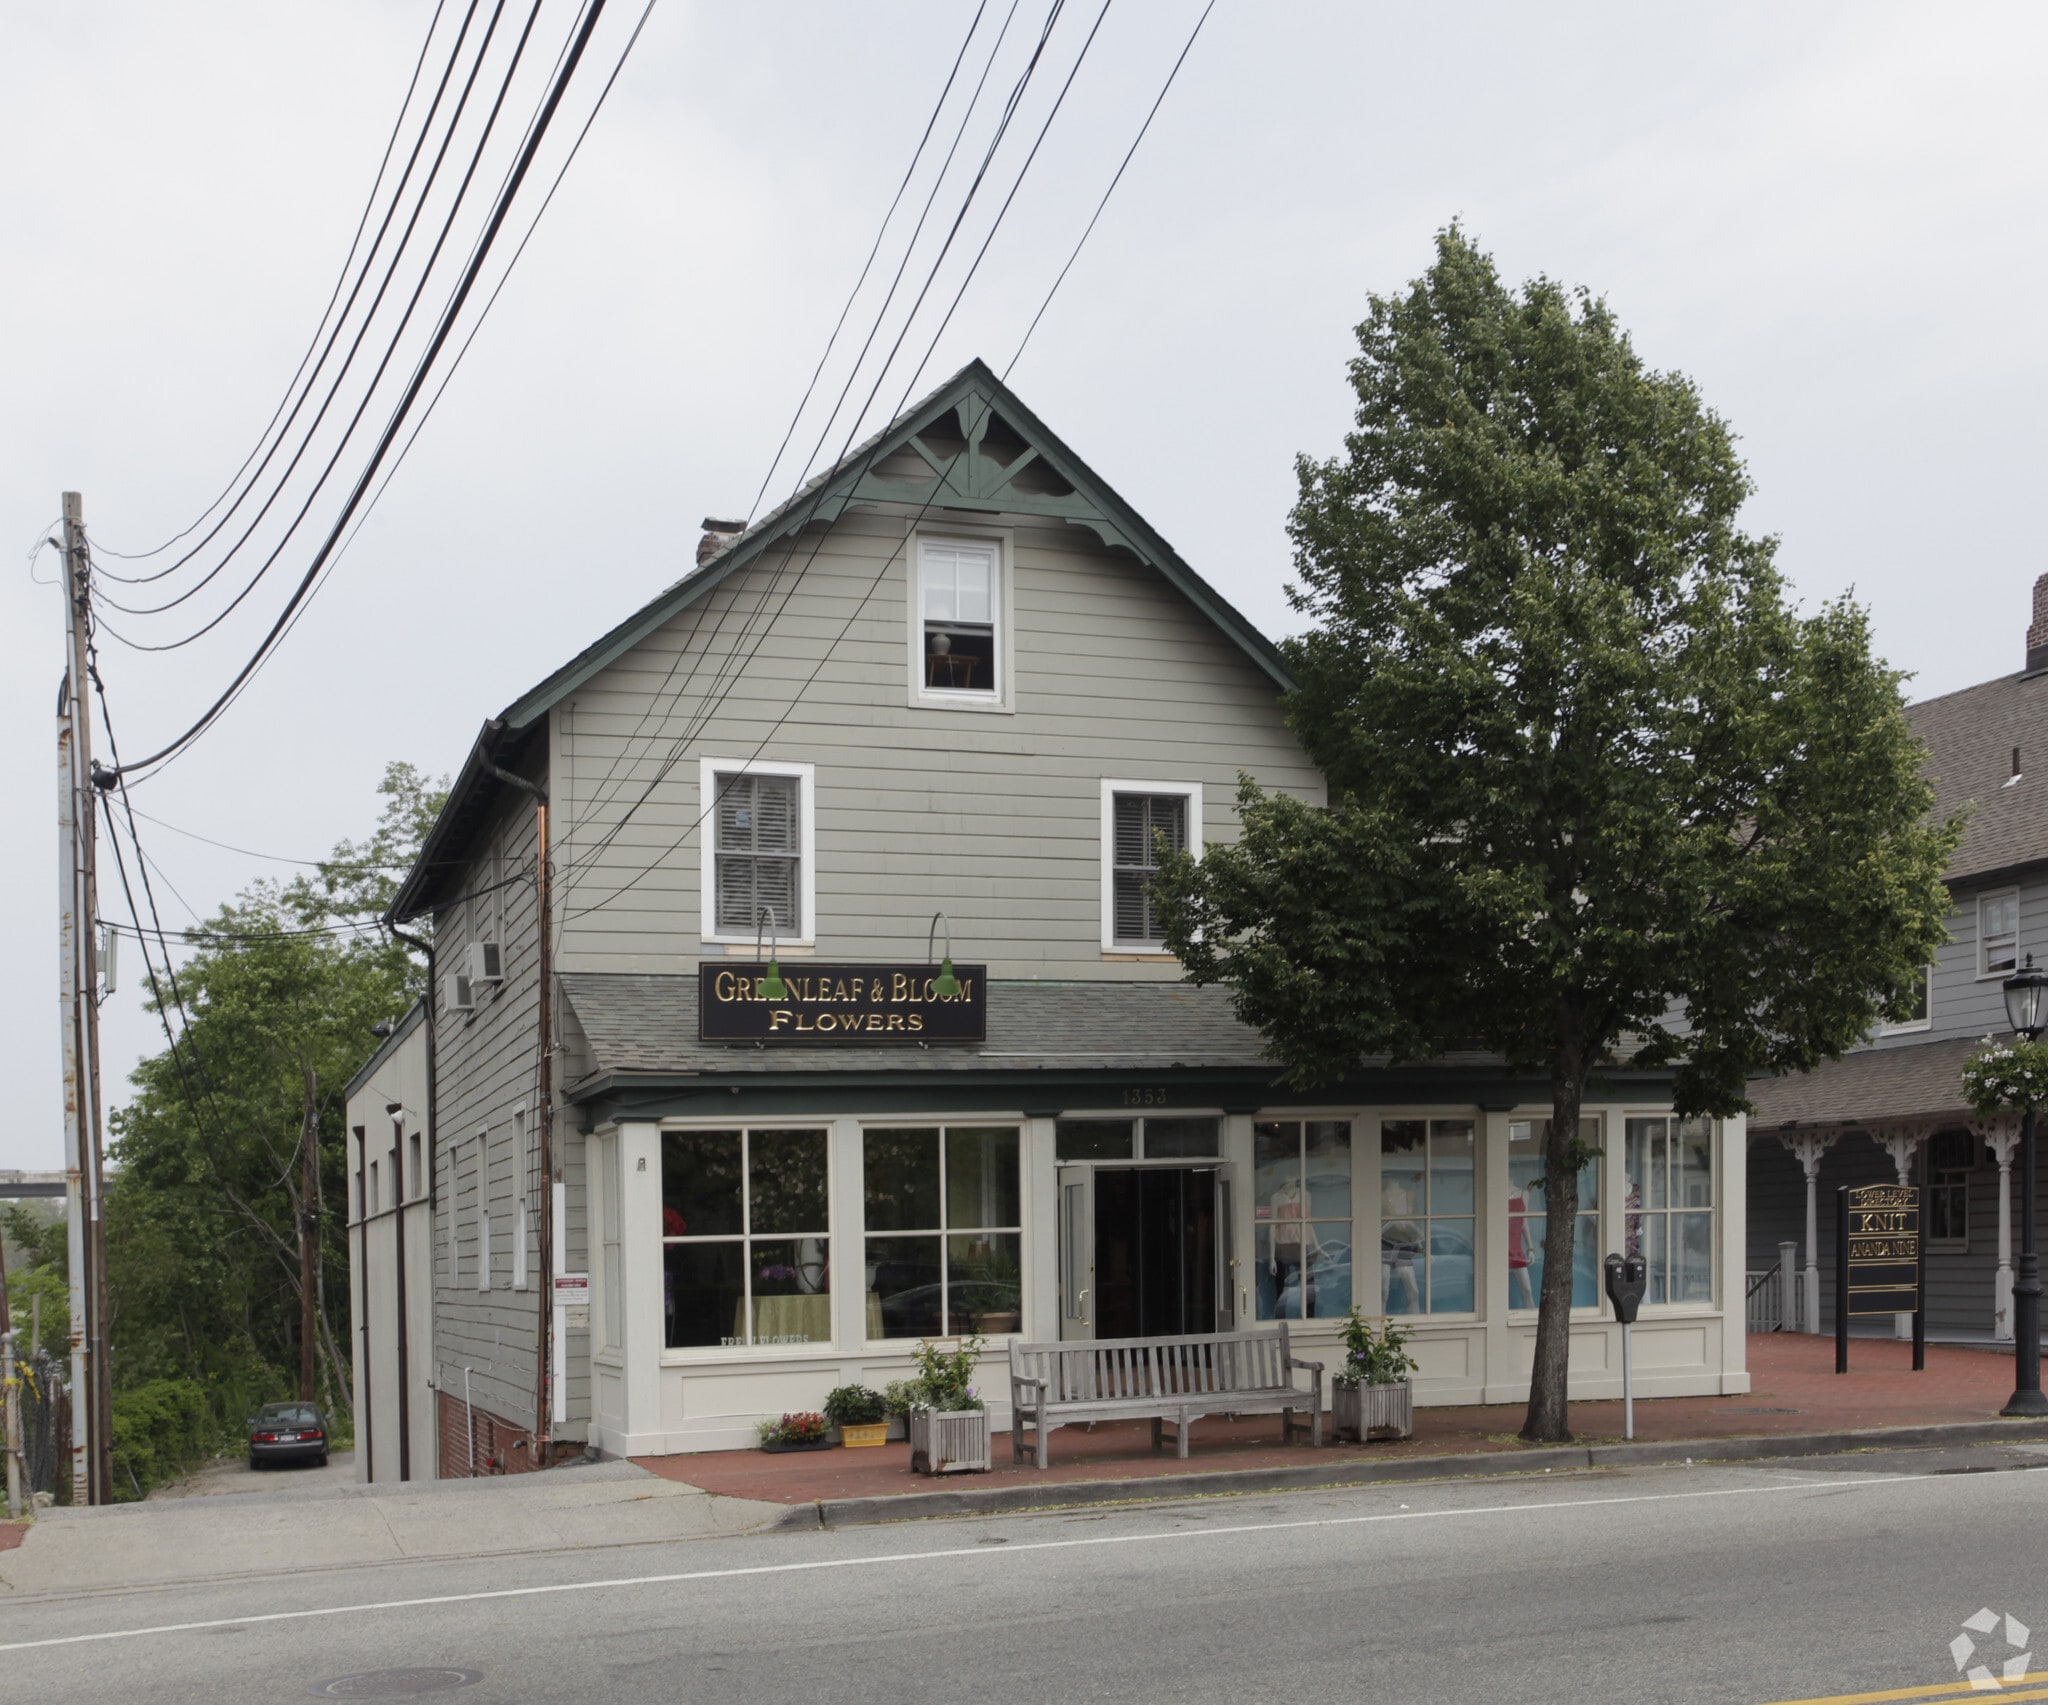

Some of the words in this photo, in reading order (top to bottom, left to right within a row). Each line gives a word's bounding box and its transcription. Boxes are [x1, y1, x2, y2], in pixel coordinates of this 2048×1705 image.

[714, 971, 865, 1002] GRENLEAF
[871, 977, 884, 1002] &
[769, 1010, 924, 1031] FLOWERS
[1122, 1088, 1167, 1104] 1353
[1856, 1190, 1885, 1199] LOWER
[1887, 1189, 1914, 1198] LEVEL
[1860, 1198, 1909, 1208] DIRECTORY
[1861, 1213, 1907, 1231] KNIT
[1851, 1241, 1890, 1256] ANANDA
[1892, 1240, 1916, 1255] NINE
[759, 1334, 809, 1345] FLOWERS
